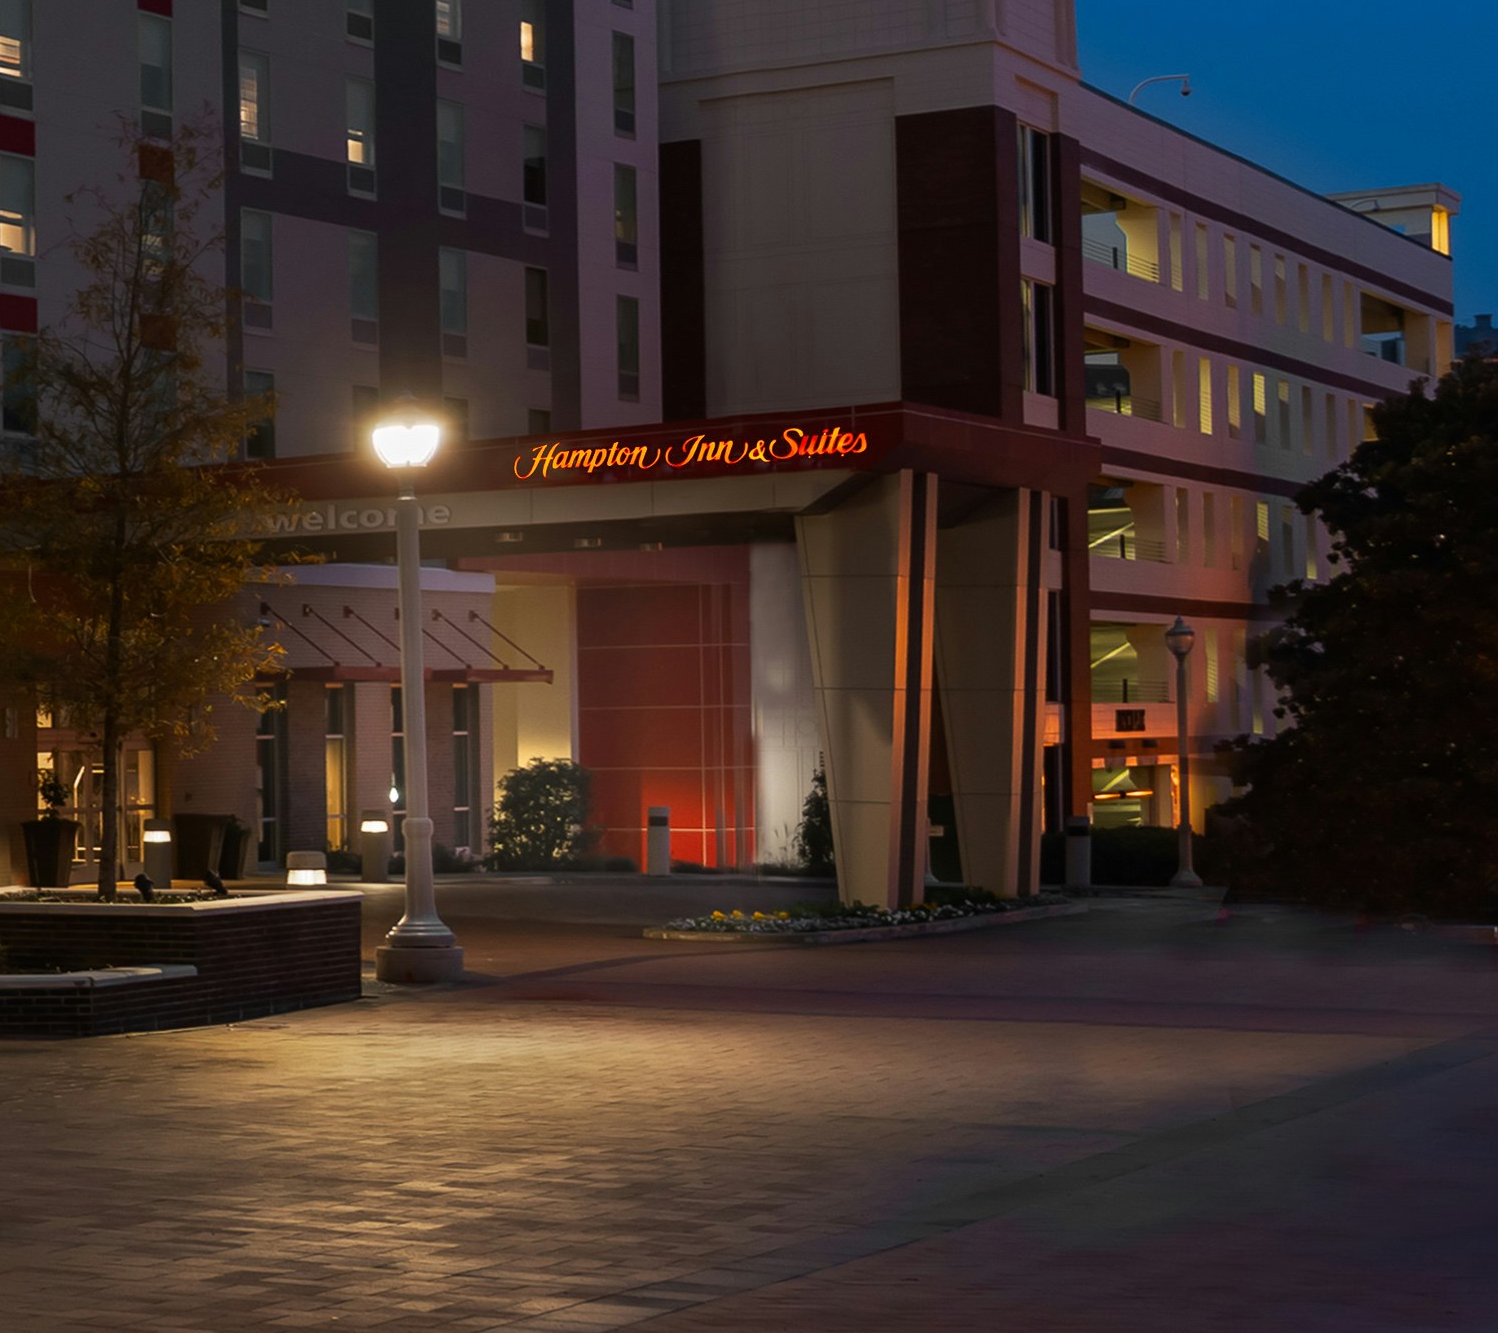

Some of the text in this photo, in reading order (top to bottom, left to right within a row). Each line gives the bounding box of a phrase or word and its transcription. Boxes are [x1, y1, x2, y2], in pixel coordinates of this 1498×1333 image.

[513, 426, 868, 479] Hampton Inn & Suites
